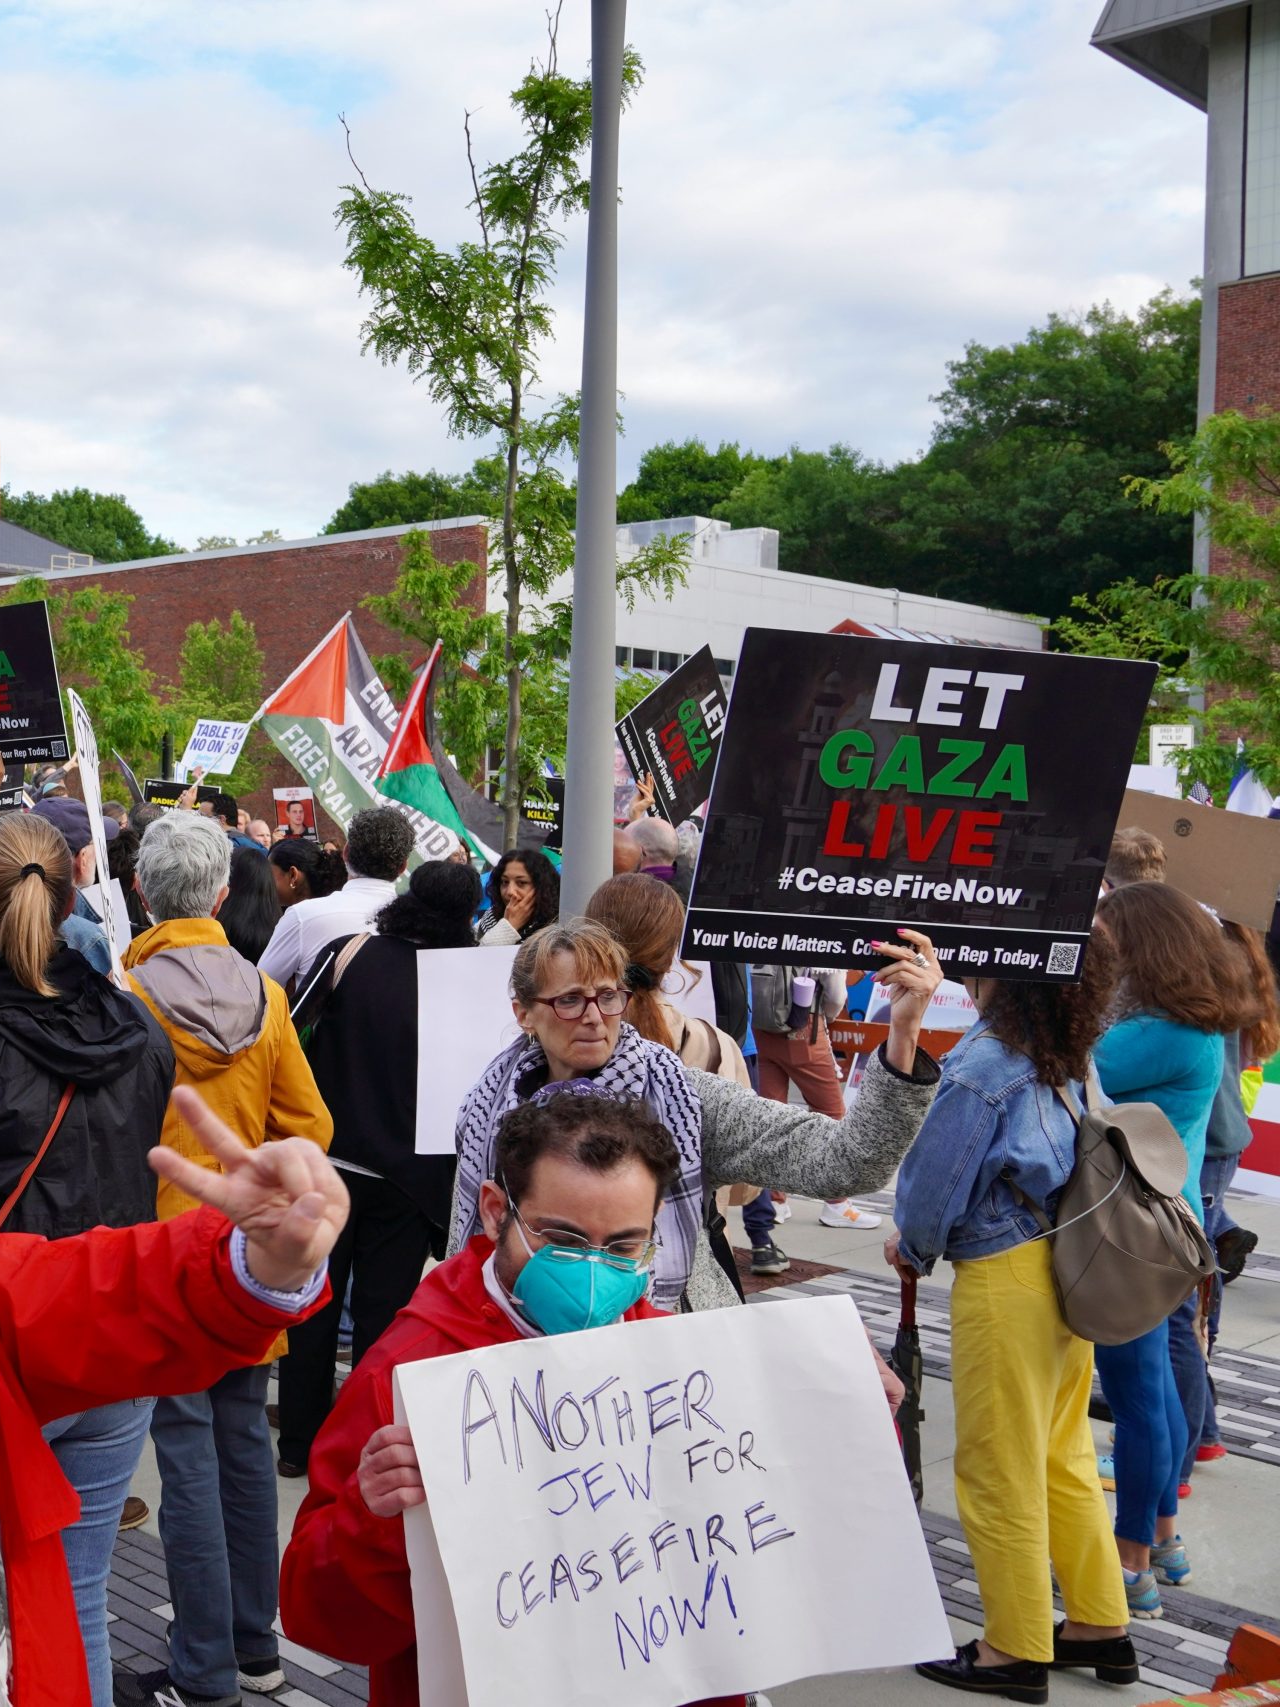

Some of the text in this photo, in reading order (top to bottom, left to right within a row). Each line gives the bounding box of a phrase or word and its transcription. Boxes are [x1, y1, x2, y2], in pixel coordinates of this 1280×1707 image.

[359, 677, 401, 732] END
[699, 689, 726, 741] LET
[869, 661, 1025, 731] LET
[14, 749, 27, 759] Rep
[28, 747, 51, 758] Today.
[190, 738, 206, 751] NO
[207, 739, 224, 753] ON
[196, 723, 230, 739] TABLE
[279, 723, 330, 779] FREE
[659, 719, 694, 782] LIVE
[677, 698, 713, 771] GAZA
[645, 727, 677, 801] #CeaseFireNow
[819, 729, 1029, 803] GAZA
[151, 796, 180, 807] RADICA
[822, 799, 1005, 868] LIVE
[778, 864, 1023, 907] #CeaseFireNow
[691, 928, 730, 948] Your
[732, 930, 779, 950] Voice
[782, 934, 847, 954] Matters.
[933, 946, 957, 961] our
[958, 945, 990, 966] Rep
[993, 947, 1044, 968] Today.
[831, 1029, 866, 1046] DPW
[462, 1368, 725, 1485] ANOTHER
[538, 1430, 767, 1517] JEW FOR
[495, 1500, 795, 1629] CEASEFIRE
[614, 1560, 746, 1671] NOW!
